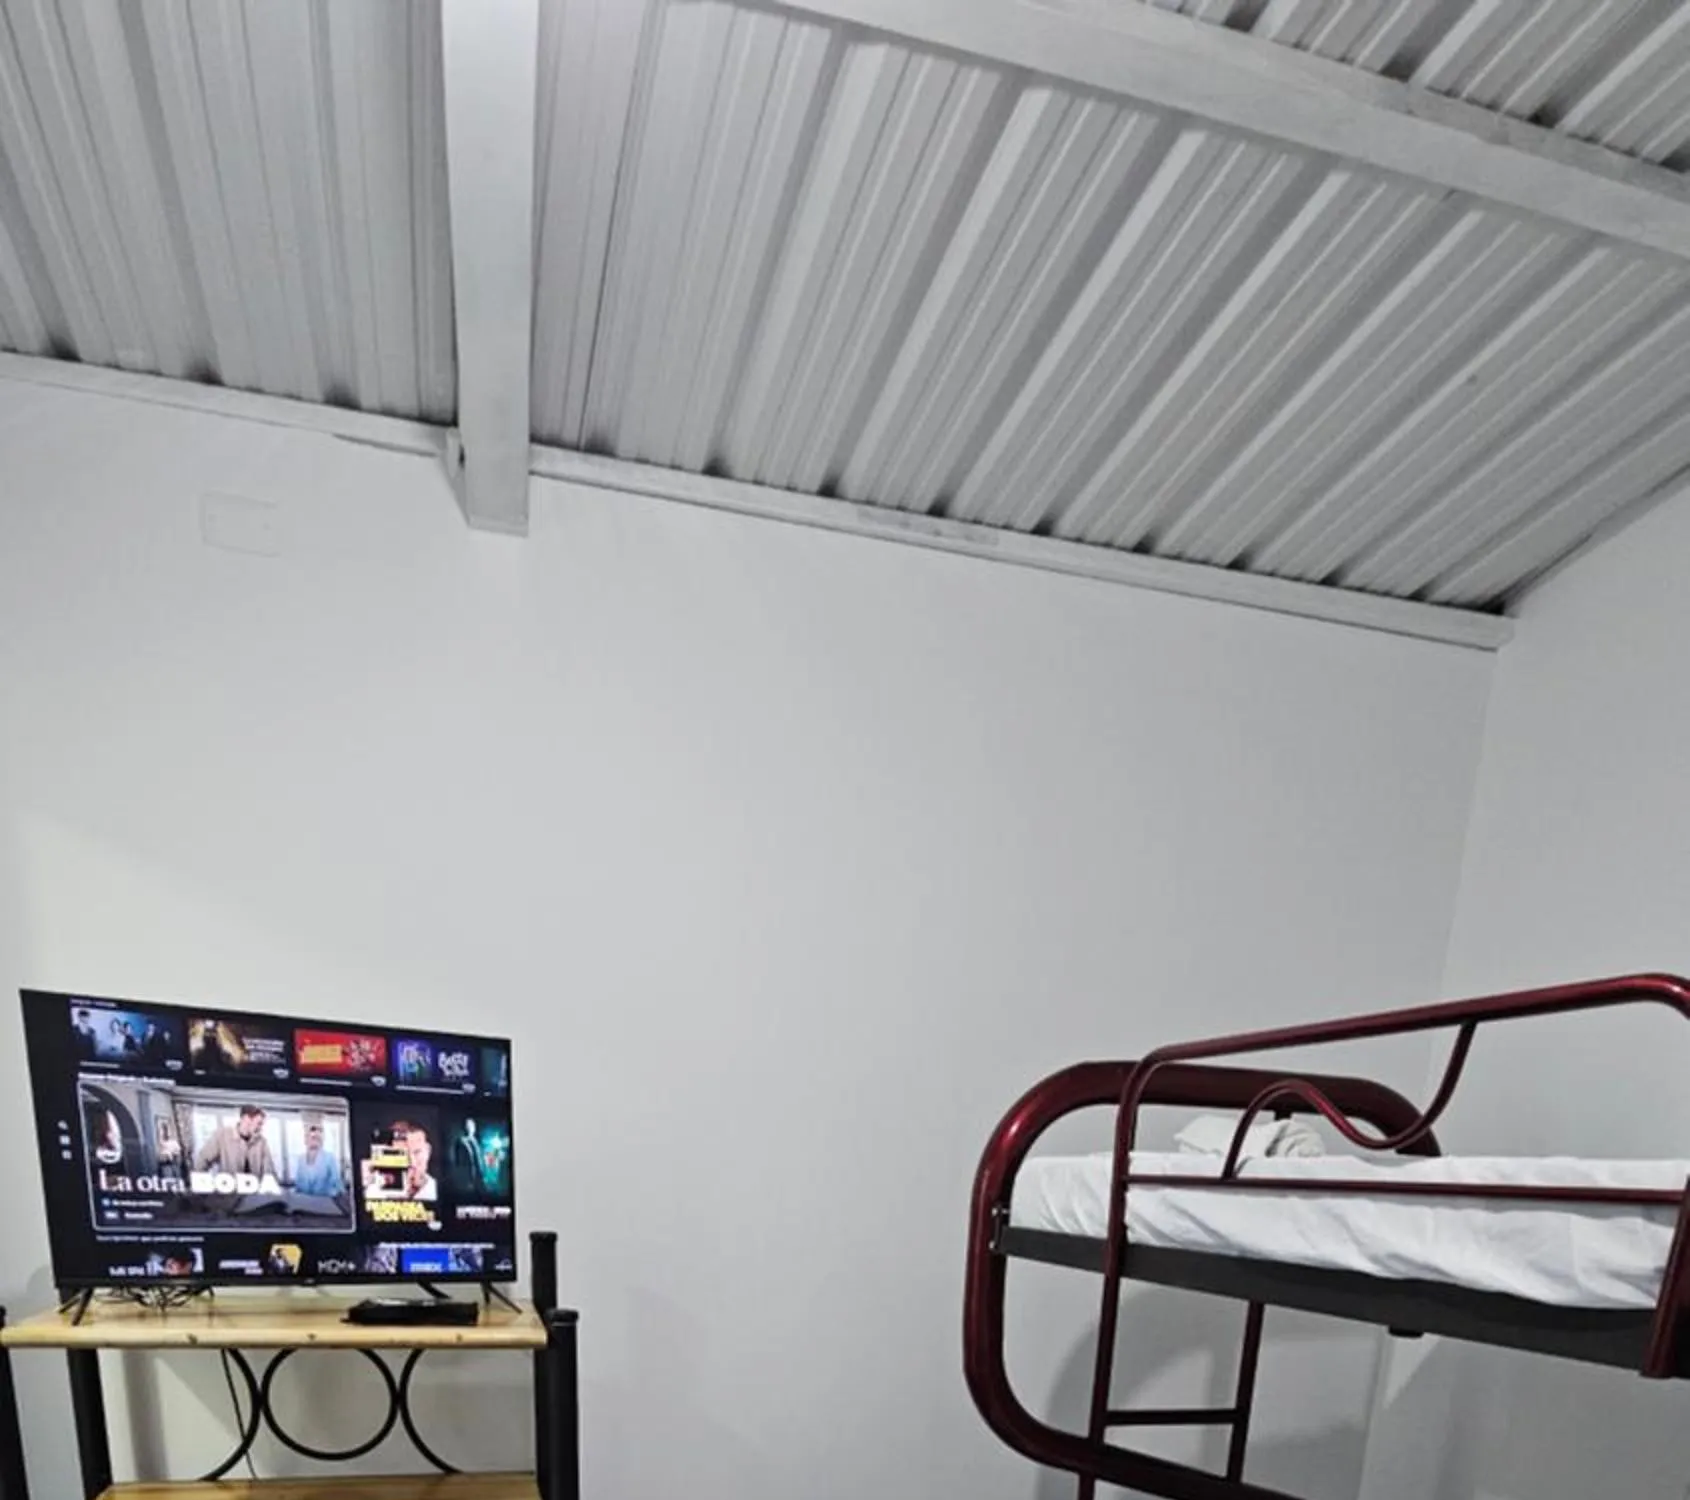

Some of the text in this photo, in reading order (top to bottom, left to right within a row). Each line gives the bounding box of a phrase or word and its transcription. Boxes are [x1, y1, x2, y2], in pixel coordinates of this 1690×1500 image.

[99, 1169, 281, 1194] La otra BODA
